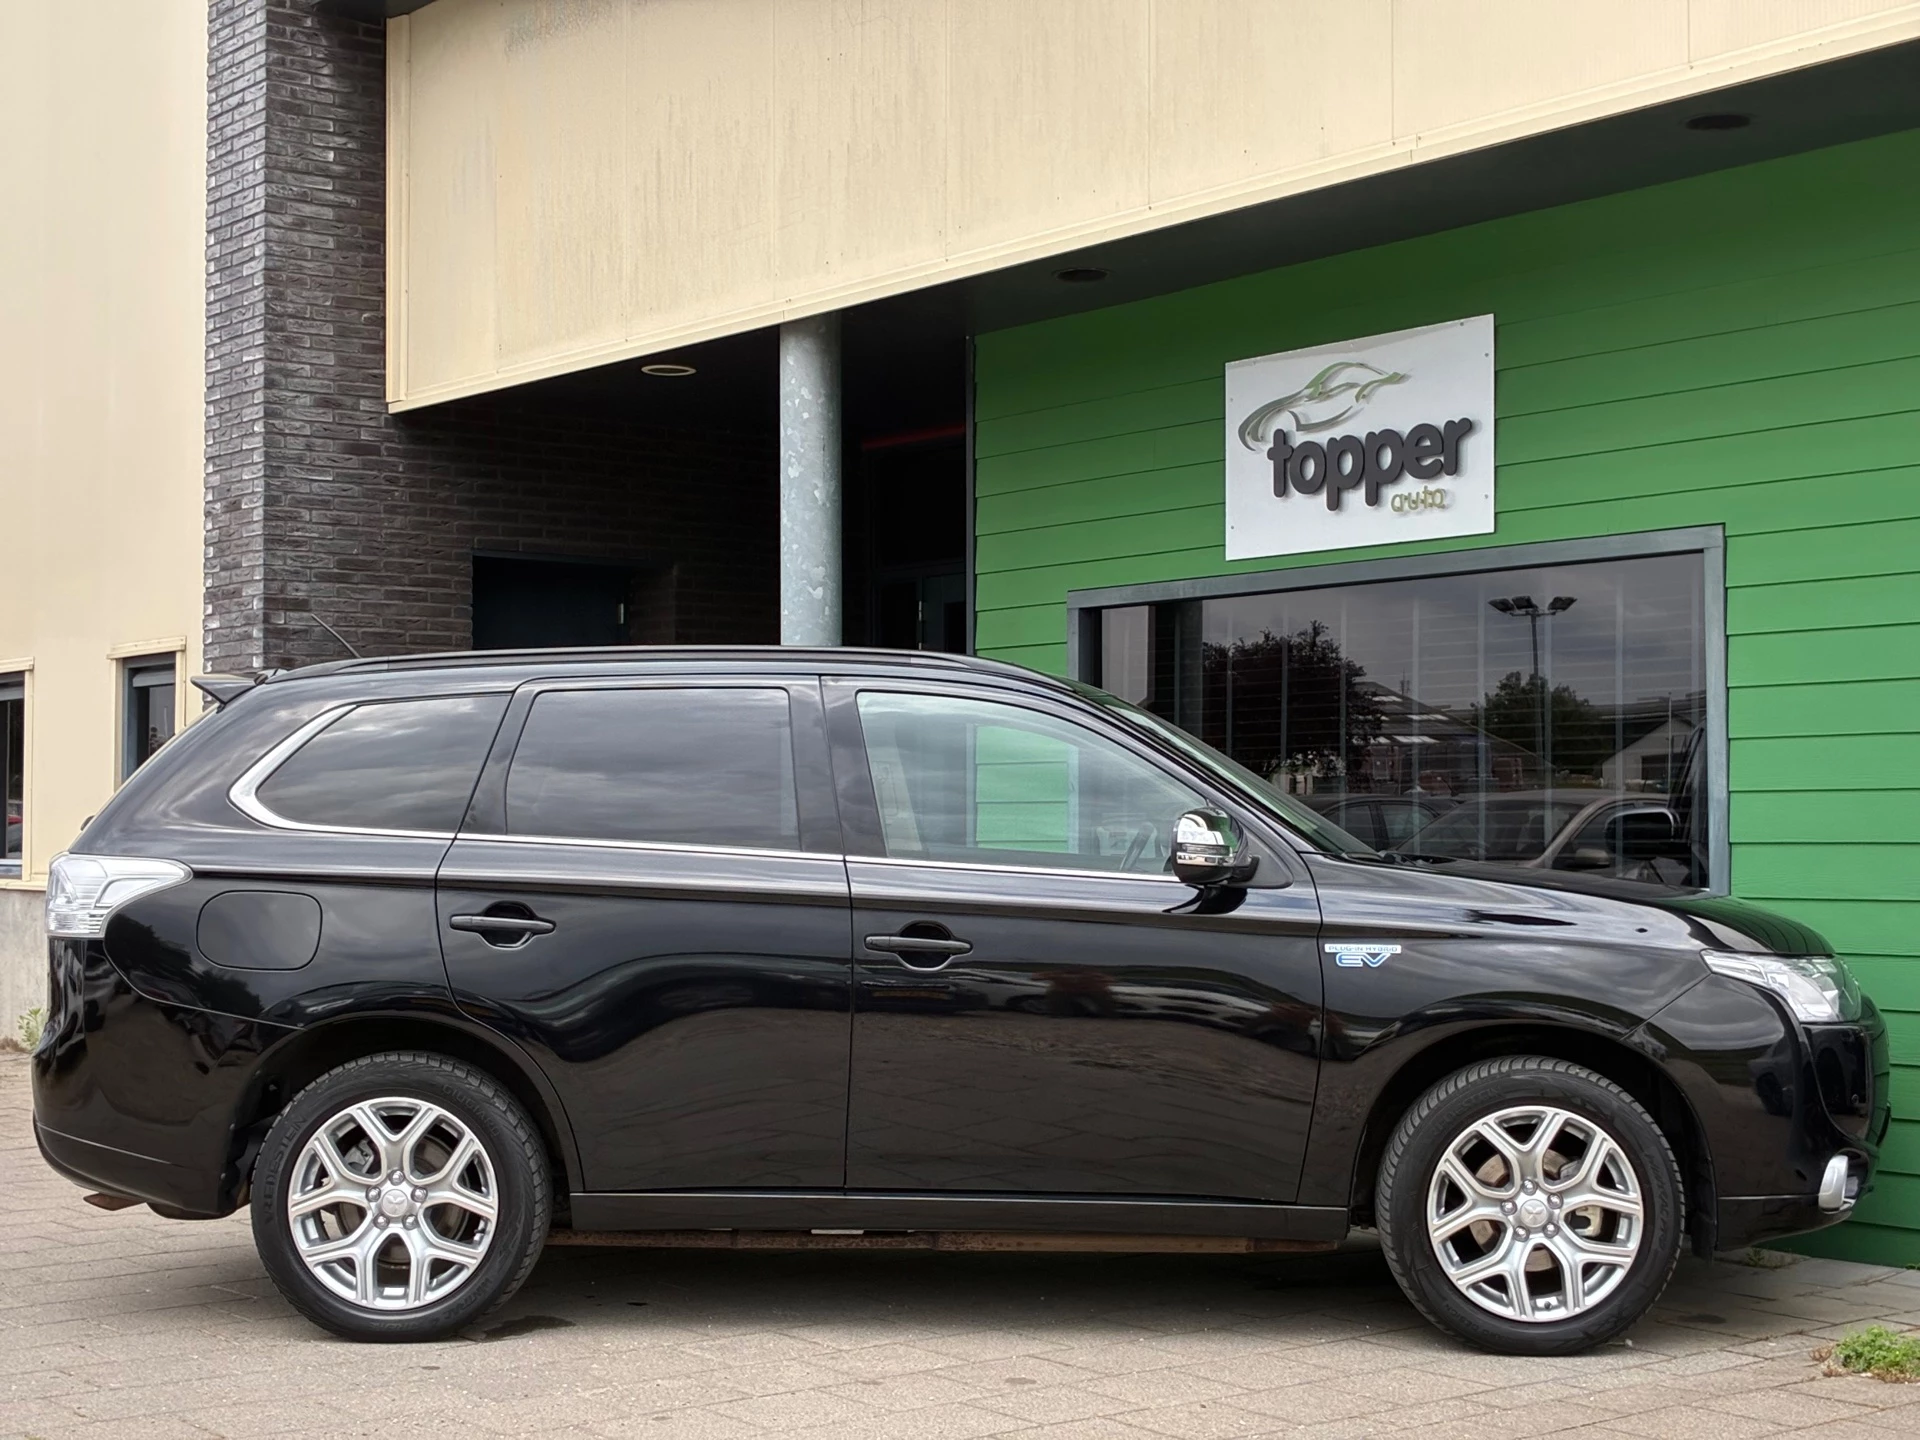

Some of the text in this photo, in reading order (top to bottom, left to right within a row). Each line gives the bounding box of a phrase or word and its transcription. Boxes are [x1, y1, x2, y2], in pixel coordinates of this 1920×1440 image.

[1267, 418, 1472, 511] topper
[1391, 485, 1446, 512] auto
[1336, 953, 1391, 967] EV
[264, 1117, 306, 1224] VREDESTEIN
